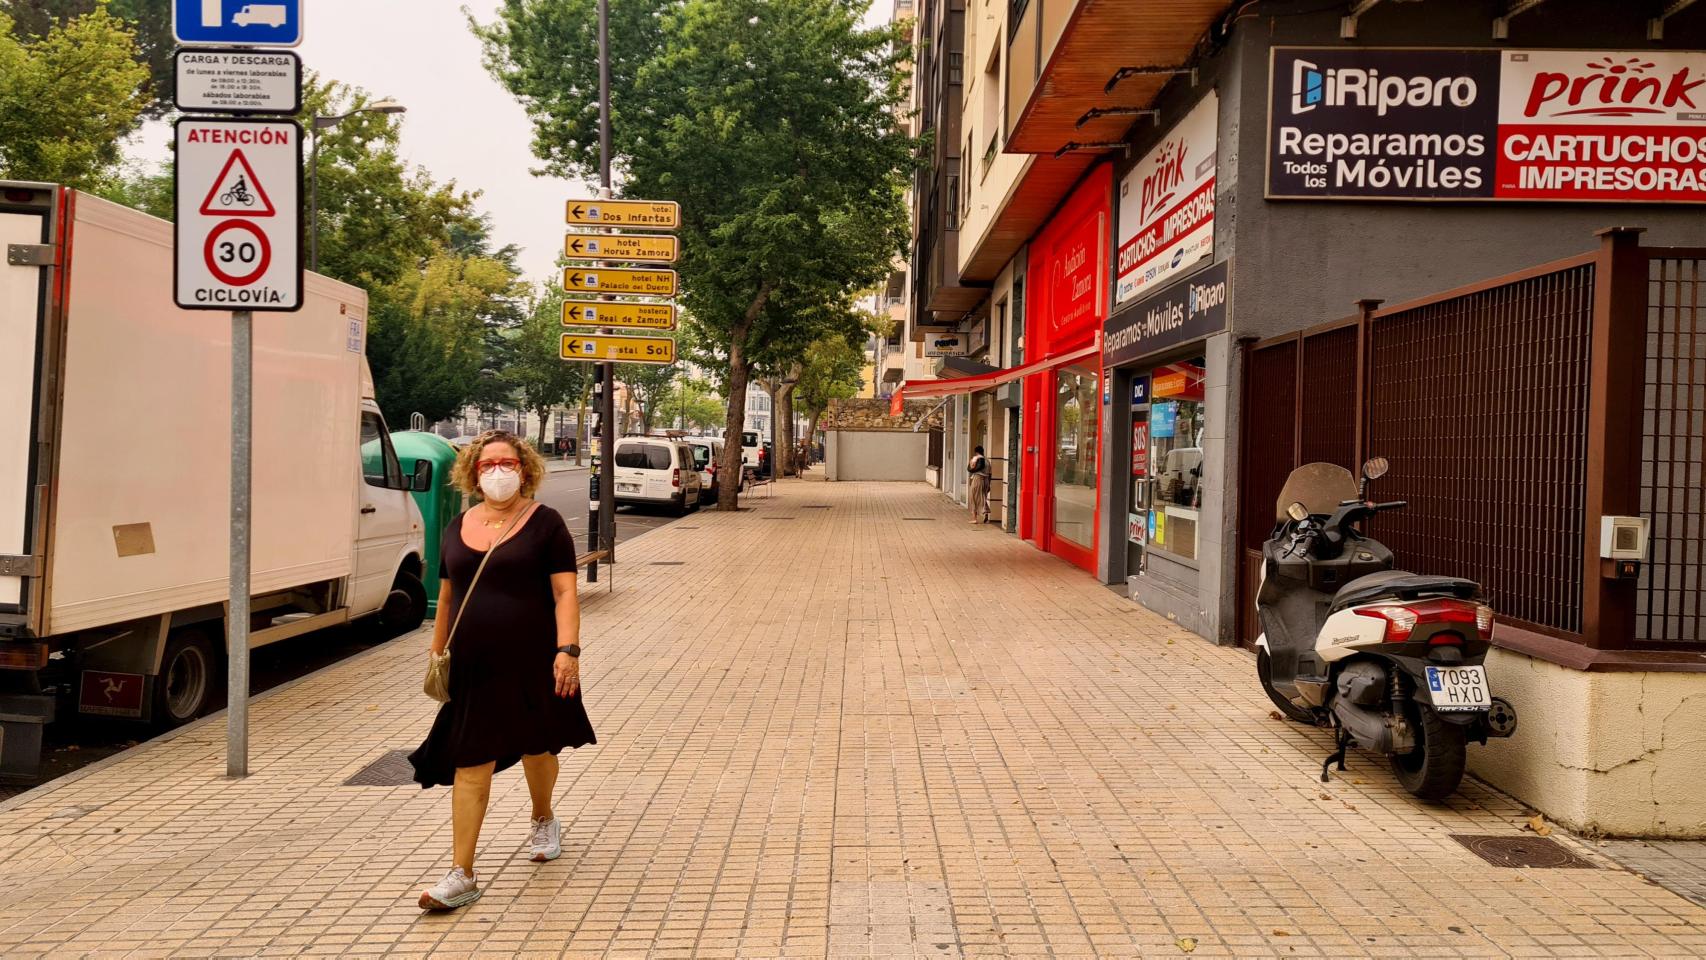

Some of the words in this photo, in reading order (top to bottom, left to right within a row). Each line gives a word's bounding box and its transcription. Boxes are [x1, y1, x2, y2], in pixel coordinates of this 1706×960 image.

[183, 55, 220, 63] CARGA
[223, 56, 229, 64] Y
[231, 56, 290, 66] DESCARGA
[196, 68, 215, 76] lunes
[223, 68, 248, 76] viernes
[249, 69, 287, 77] laborables
[233, 92, 270, 100] laborables
[1325, 68, 1477, 116] iRiparo
[1523, 65, 1706, 117] prink
[187, 127, 288, 145] ATENCIÓN
[1279, 127, 1485, 162] Reparamos
[1283, 161, 1328, 175] Todos
[1335, 158, 1482, 188] Móviles
[1140, 136, 1188, 226] prink
[1305, 175, 1327, 188] los
[603, 213, 622, 221] Dos
[616, 239, 641, 247] hotel
[219, 242, 256, 263] 30
[603, 247, 630, 255] Horus
[636, 248, 670, 257] Zamora
[1119, 229, 1156, 274] CARTUCHOS
[195, 287, 281, 303] CICLOVÍA
[599, 314, 616, 322] Real
[622, 315, 632, 323] de
[637, 316, 668, 324] Zamora
[1103, 321, 1142, 358] Reparamos
[1146, 300, 1184, 338] Móviles
[1196, 281, 1226, 316] iRiparo
[646, 345, 668, 355] Sol
[1134, 384, 1144, 398] DIGI
[1133, 425, 1146, 451] SOS
[1436, 669, 1481, 685] 7093
[1447, 687, 1484, 702] HXD
